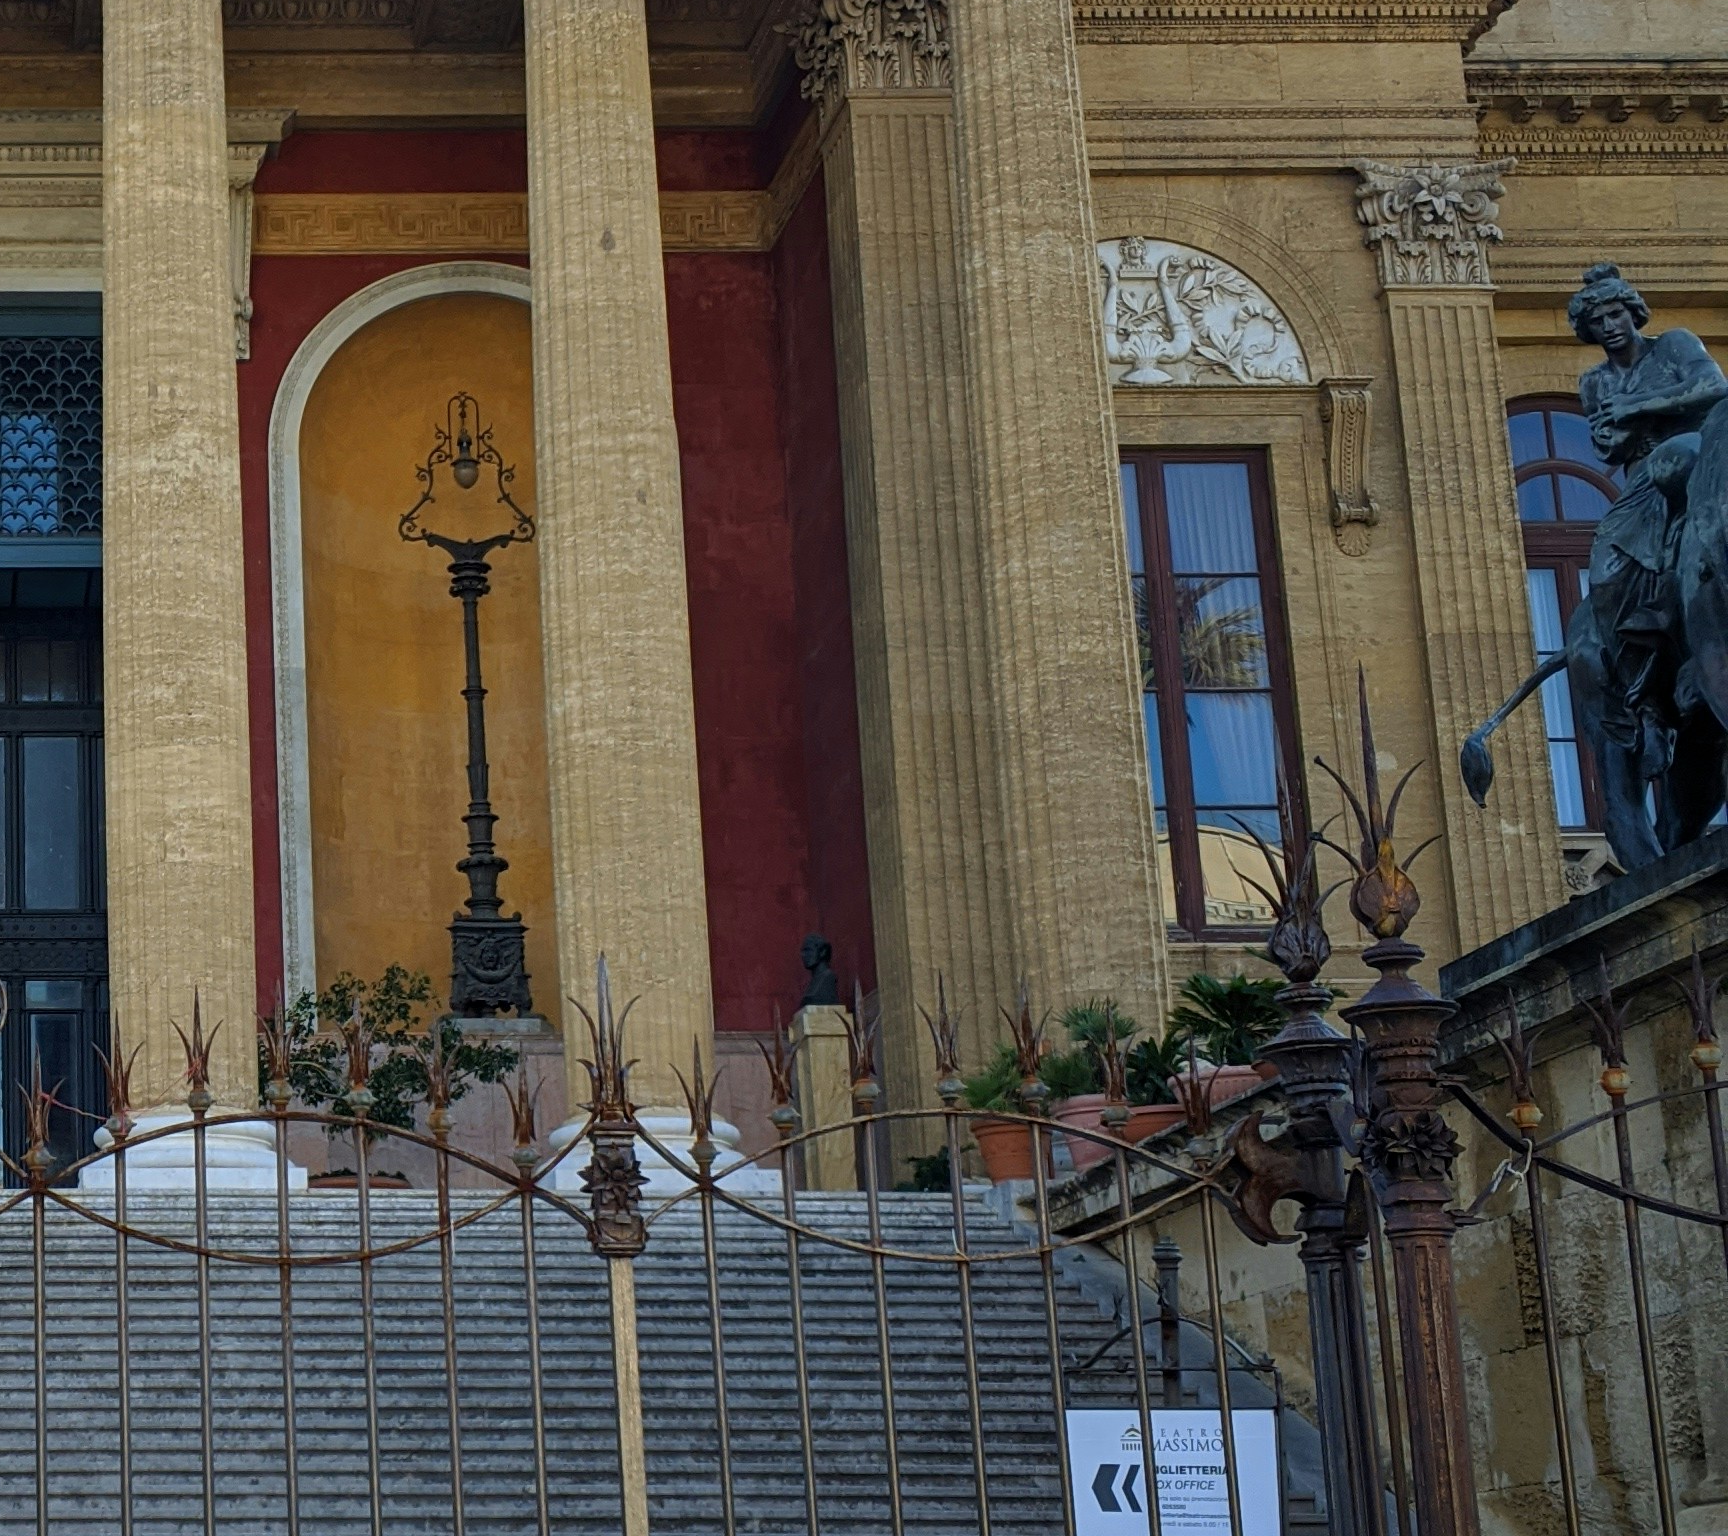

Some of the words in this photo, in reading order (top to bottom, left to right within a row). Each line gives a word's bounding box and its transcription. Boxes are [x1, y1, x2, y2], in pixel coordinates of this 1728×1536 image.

[1160, 1428, 1223, 1438] EATRO
[1155, 1465, 1228, 1475] IGLIETTERI
[1156, 1480, 1172, 1490] OX
[1175, 1480, 1215, 1490] OFFICE
